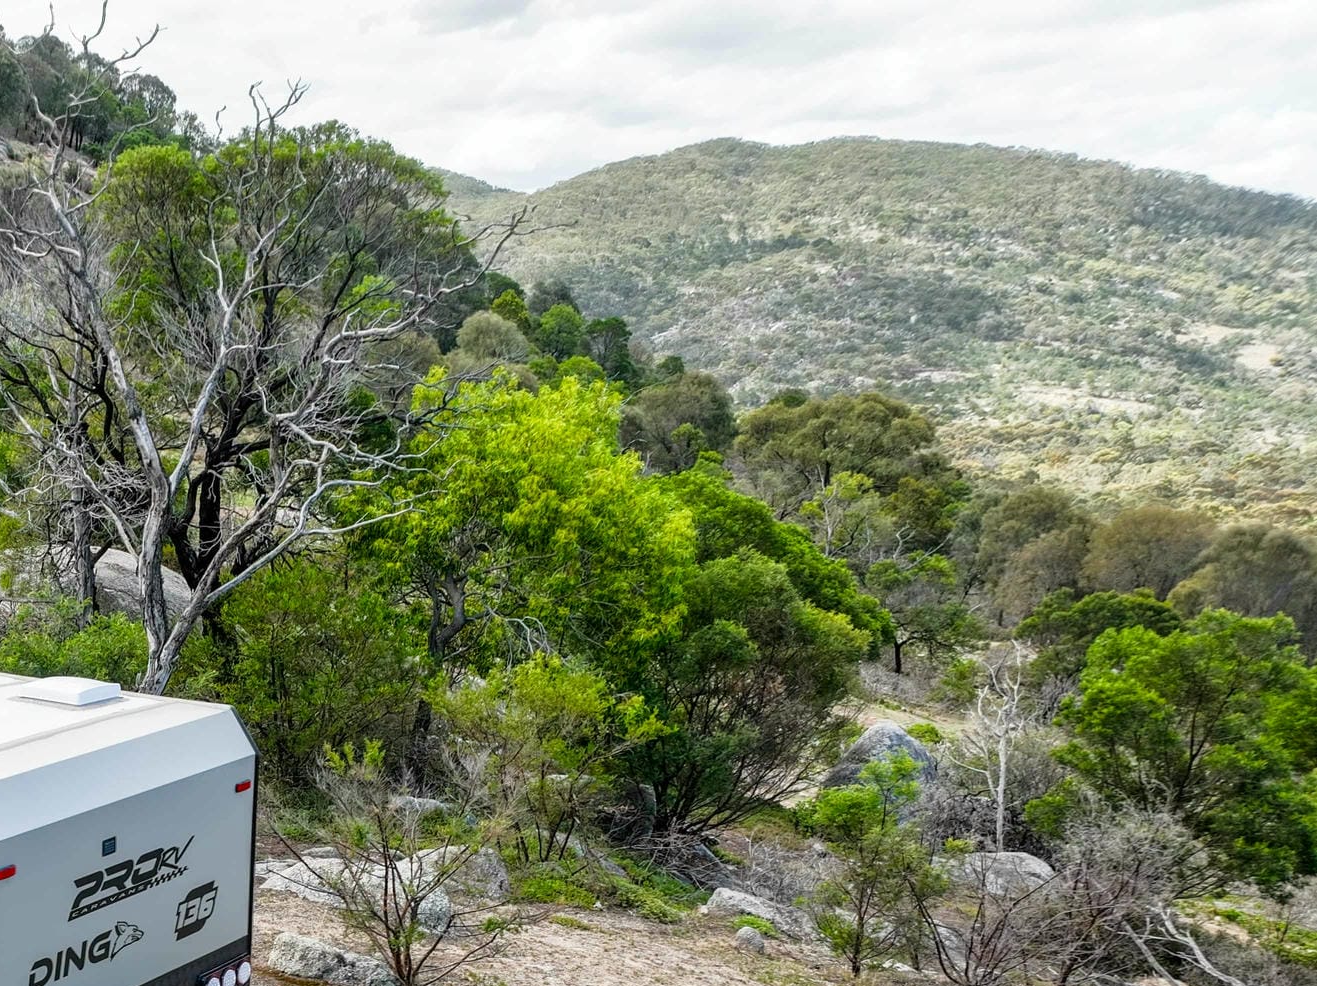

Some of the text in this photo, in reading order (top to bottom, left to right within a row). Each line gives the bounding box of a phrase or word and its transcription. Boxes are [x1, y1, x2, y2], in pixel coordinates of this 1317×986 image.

[70, 847, 164, 911] PRO
[71, 884, 145, 918] CARAVANS
[175, 886, 218, 934] 136
